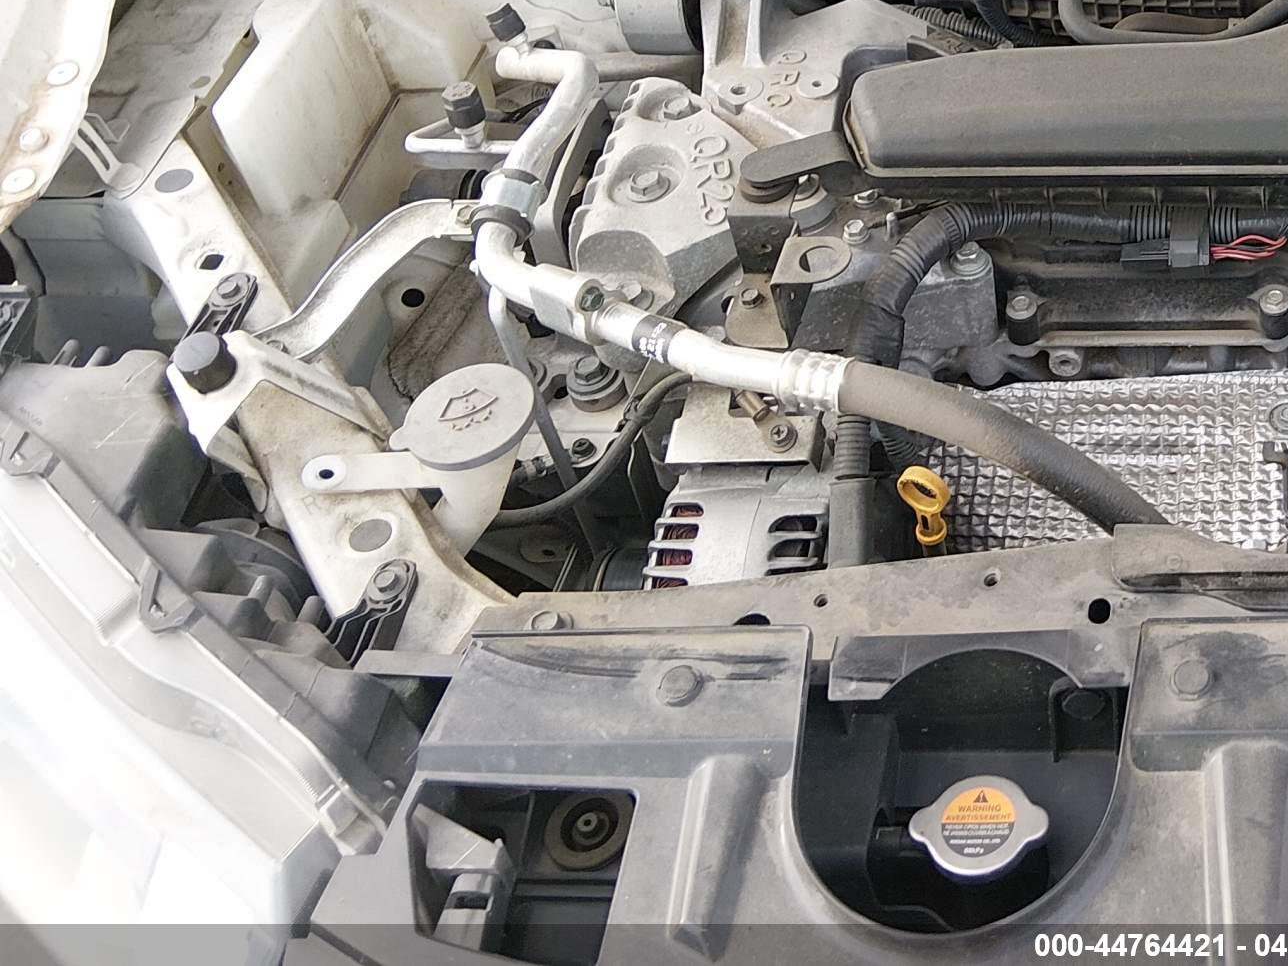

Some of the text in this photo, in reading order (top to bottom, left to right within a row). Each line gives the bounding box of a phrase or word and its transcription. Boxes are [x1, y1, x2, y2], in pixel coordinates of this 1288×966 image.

[689, 135, 736, 226] QR25
[958, 804, 1001, 813] WARNING
[945, 813, 1012, 821] AVERTISSEMENT
